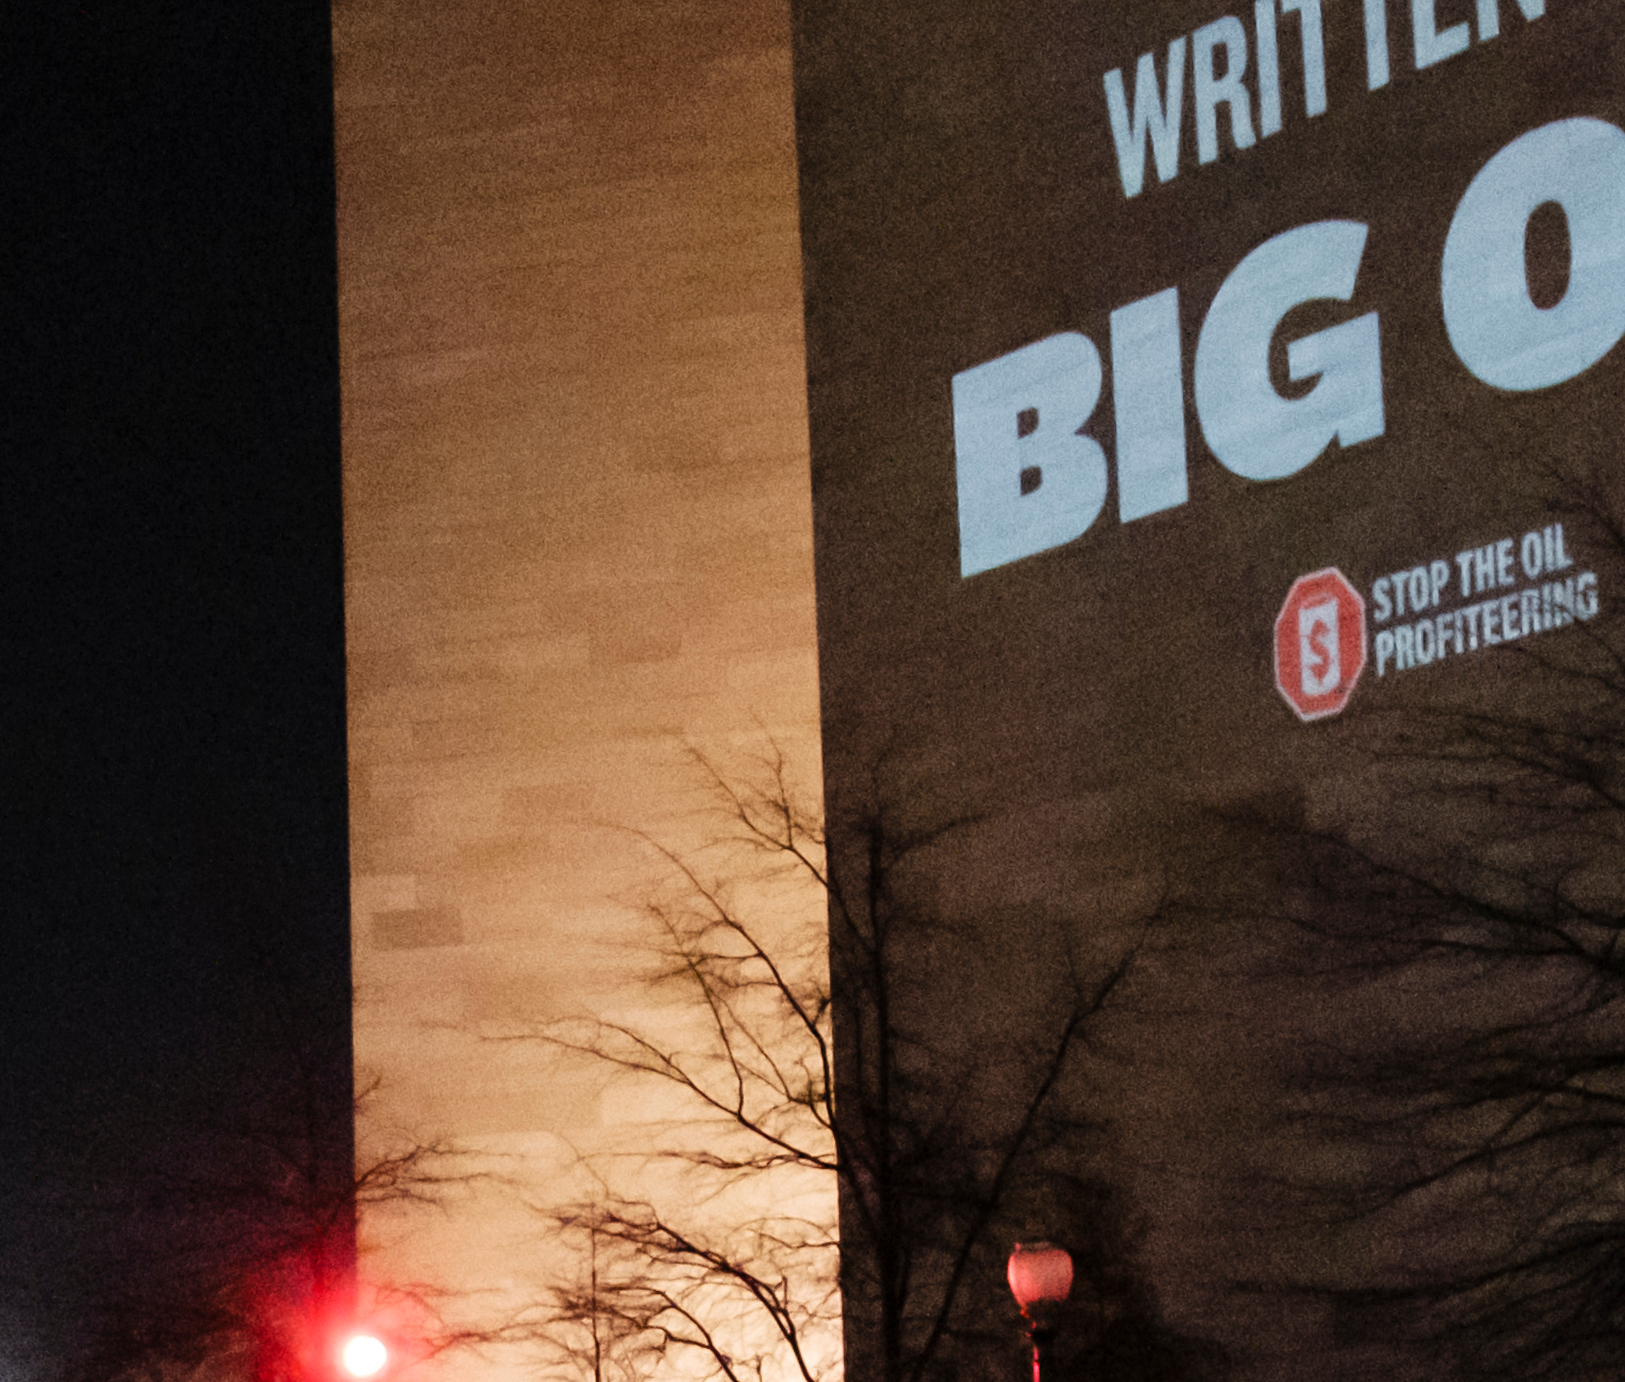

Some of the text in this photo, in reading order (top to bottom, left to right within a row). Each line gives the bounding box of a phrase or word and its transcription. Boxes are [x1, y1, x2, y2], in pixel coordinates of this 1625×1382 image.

[952, 219, 1385, 577] BIG
[1371, 522, 1573, 621] STOP THE OIL
[1375, 571, 1599, 677] PROFITEERING
